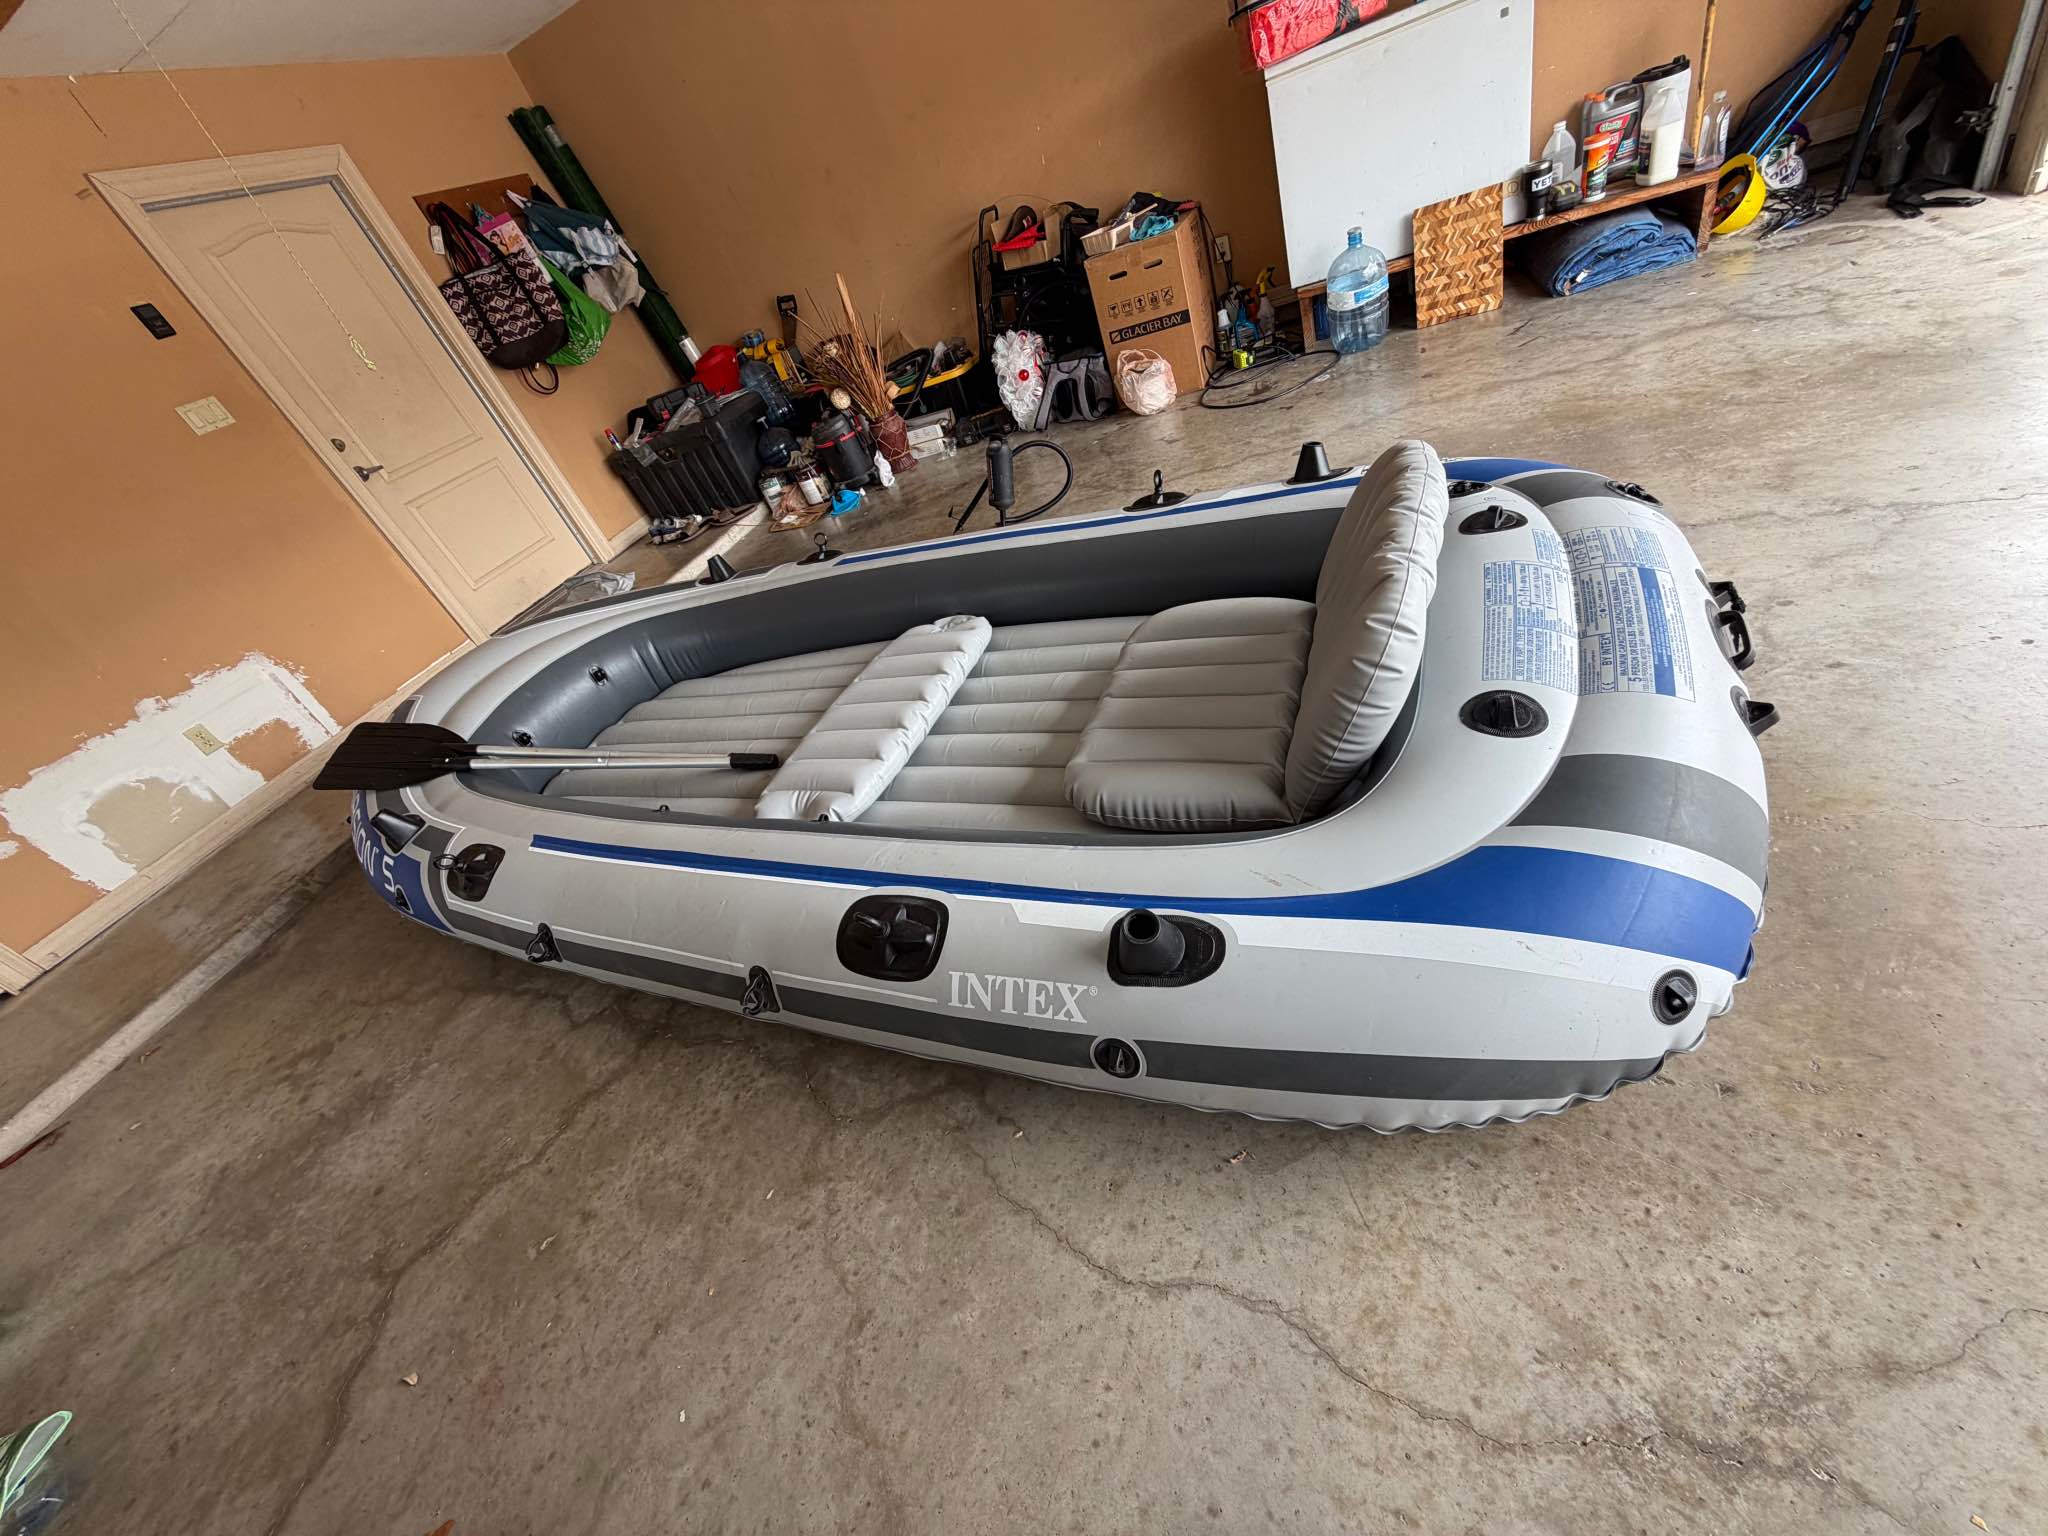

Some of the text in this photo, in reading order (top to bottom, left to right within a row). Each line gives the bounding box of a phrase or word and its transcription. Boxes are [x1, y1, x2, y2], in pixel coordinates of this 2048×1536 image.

[1533, 175, 1553, 189] YET
[1121, 313, 1182, 339] GLACIER BAY
[1601, 656, 1612, 666] BY
[1630, 656, 1641, 676] PERSON
[382, 854, 395, 893] 5
